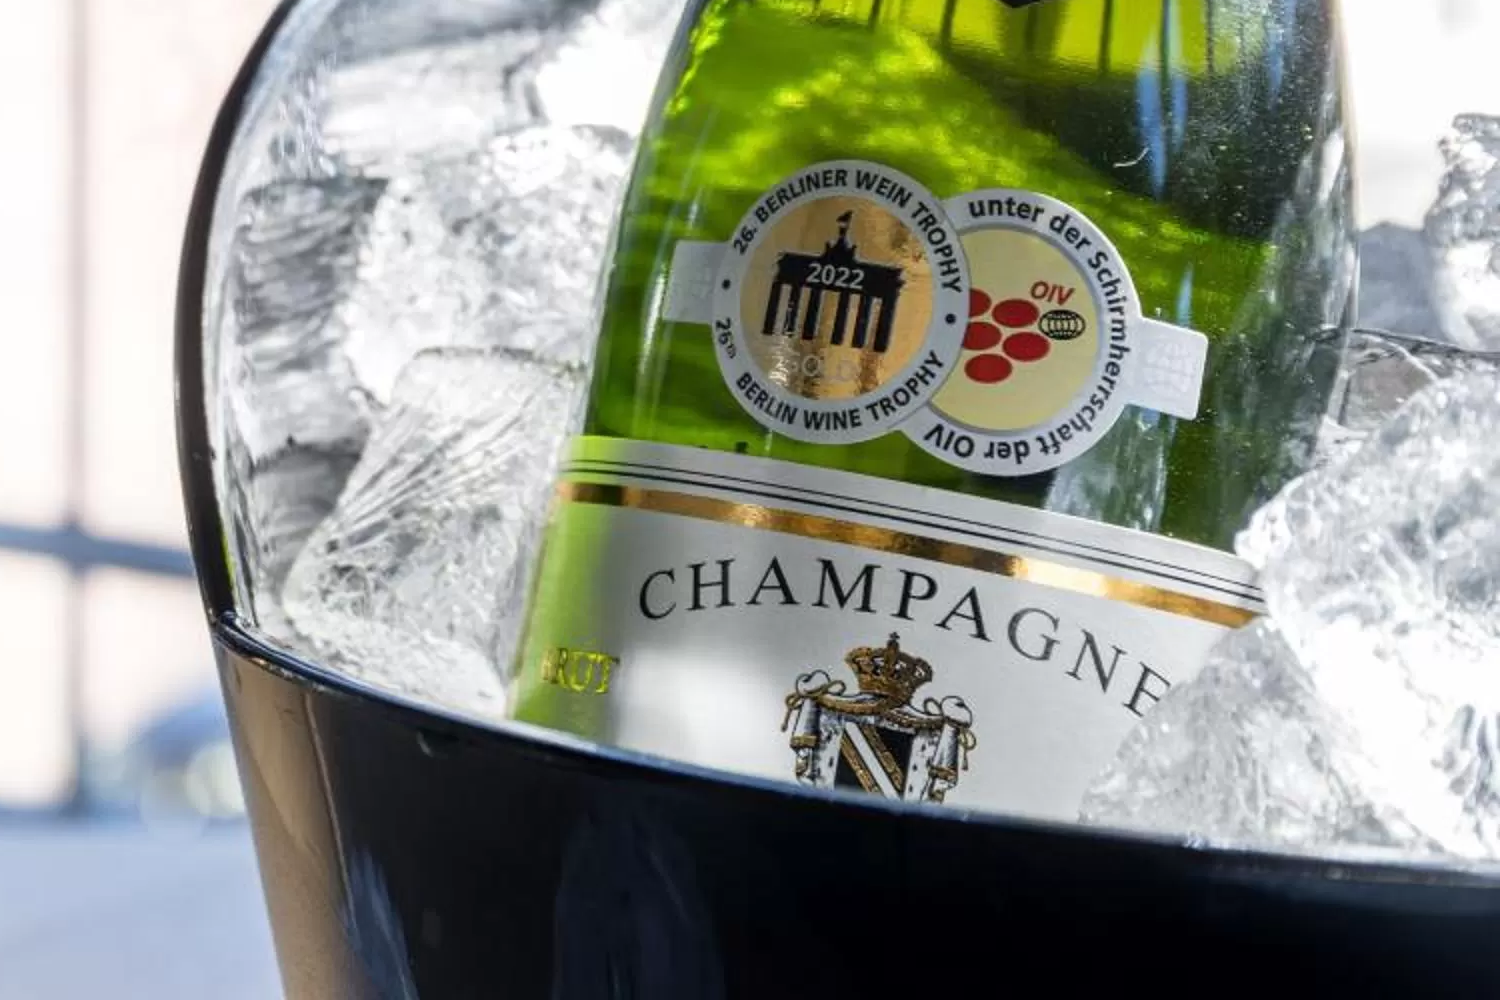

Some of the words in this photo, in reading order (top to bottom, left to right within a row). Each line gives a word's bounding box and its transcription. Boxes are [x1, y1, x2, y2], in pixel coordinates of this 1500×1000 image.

[968, 196, 1046, 223] unter
[732, 224, 758, 255] 26.
[755, 168, 849, 225] BERLINER
[855, 168, 914, 209] WEIN
[911, 201, 963, 294] TROPHY
[1049, 213, 1093, 250] der
[805, 262, 865, 290] 2022
[1030, 280, 1076, 306] OIV
[1034, 250, 1132, 456] Schirmherrschaft
[735, 371, 799, 425] BERLIN
[803, 407, 862, 431] WINE
[864, 349, 945, 422] TROPHY
[923, 422, 975, 459] OIV
[983, 438, 1031, 465] der
[638, 555, 1172, 719] CHAMPAGNE
